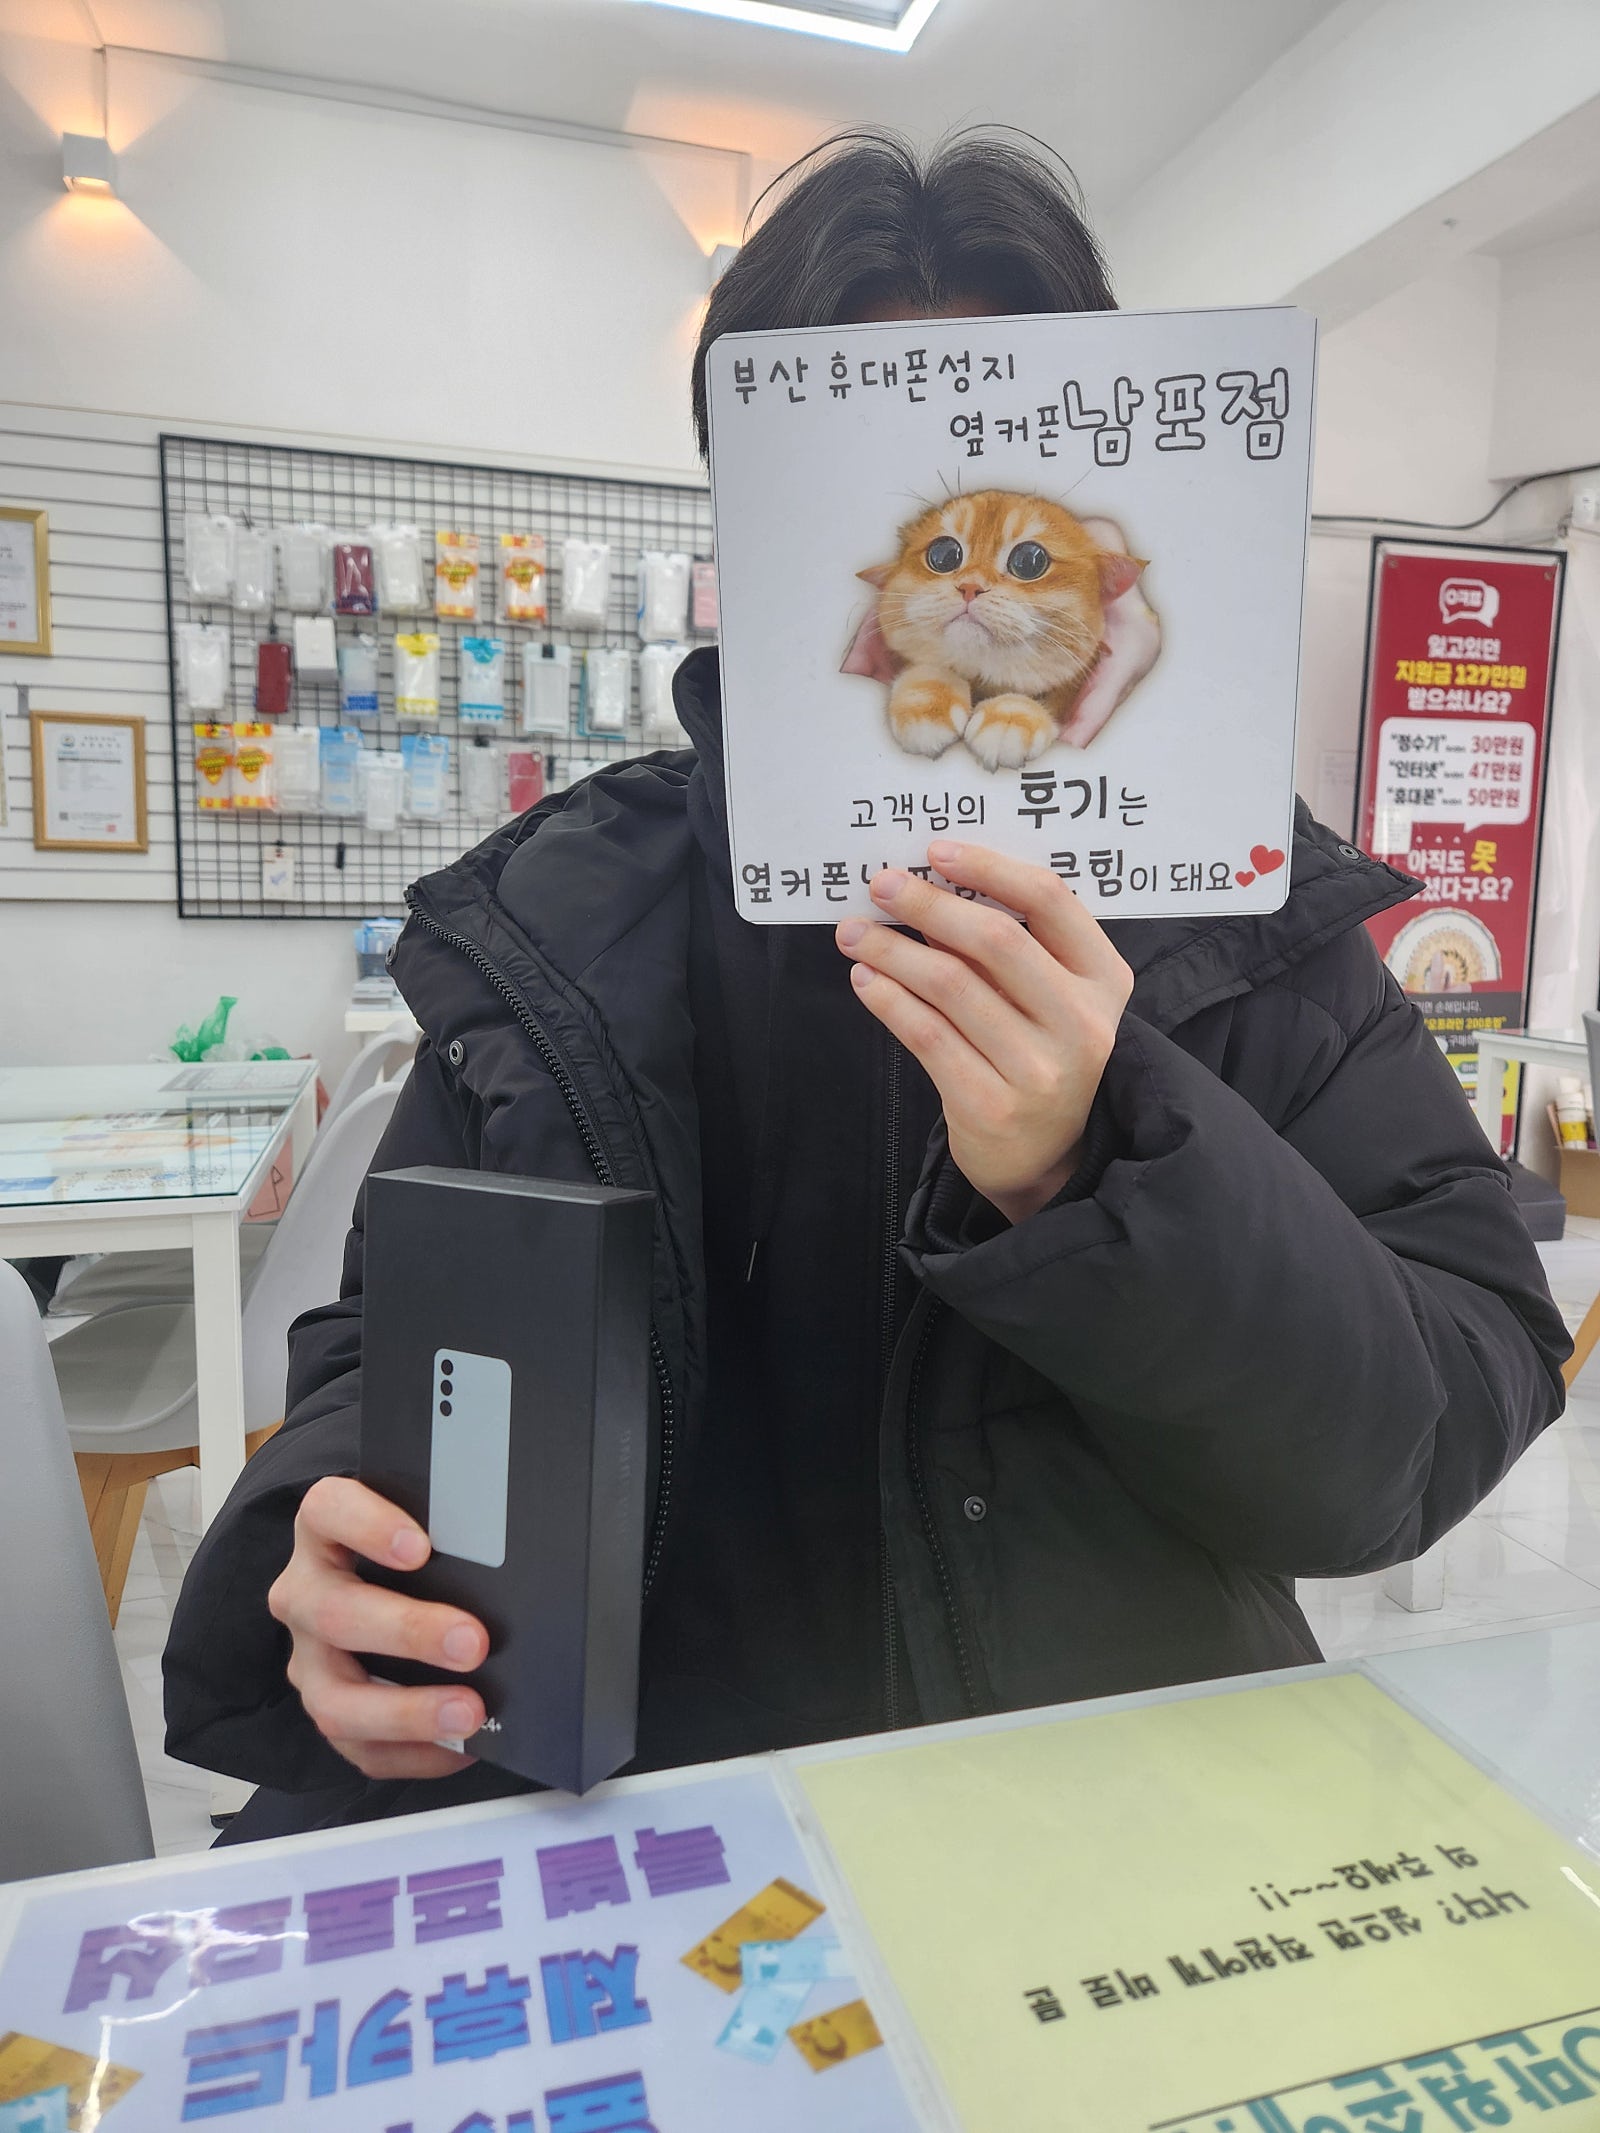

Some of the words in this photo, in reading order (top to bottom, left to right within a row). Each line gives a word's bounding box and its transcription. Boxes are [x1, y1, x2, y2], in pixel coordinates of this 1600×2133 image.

[734, 356, 808, 404] 부산
[828, 349, 1016, 402] 휴대폰성지
[1063, 367, 1291, 467] 남포점
[1395, 660, 1452, 685] 지원금
[1455, 664, 1528, 690] 127만원
[1471, 736, 1525, 757] 30만원
[1468, 763, 1522, 783] 47만원
[850, 793, 987, 832] 고객님의
[1018, 771, 1149, 829] 후기는
[1467, 787, 1521, 809] 50만원
[1407, 848, 1466, 873] 아직도
[1470, 840, 1498, 874] 못
[536, 1825, 732, 1920] 특별
[1434, 1844, 1479, 1870] 의
[62, 1858, 505, 2014] 프로모션
[1318, 1905, 1422, 1951] 싶으면
[1167, 1933, 1315, 1988] 직원에게
[1023, 1986, 1067, 2024] 문
[1080, 1968, 1160, 2009] 바로
[181, 1943, 652, 2122] 제휴카드
